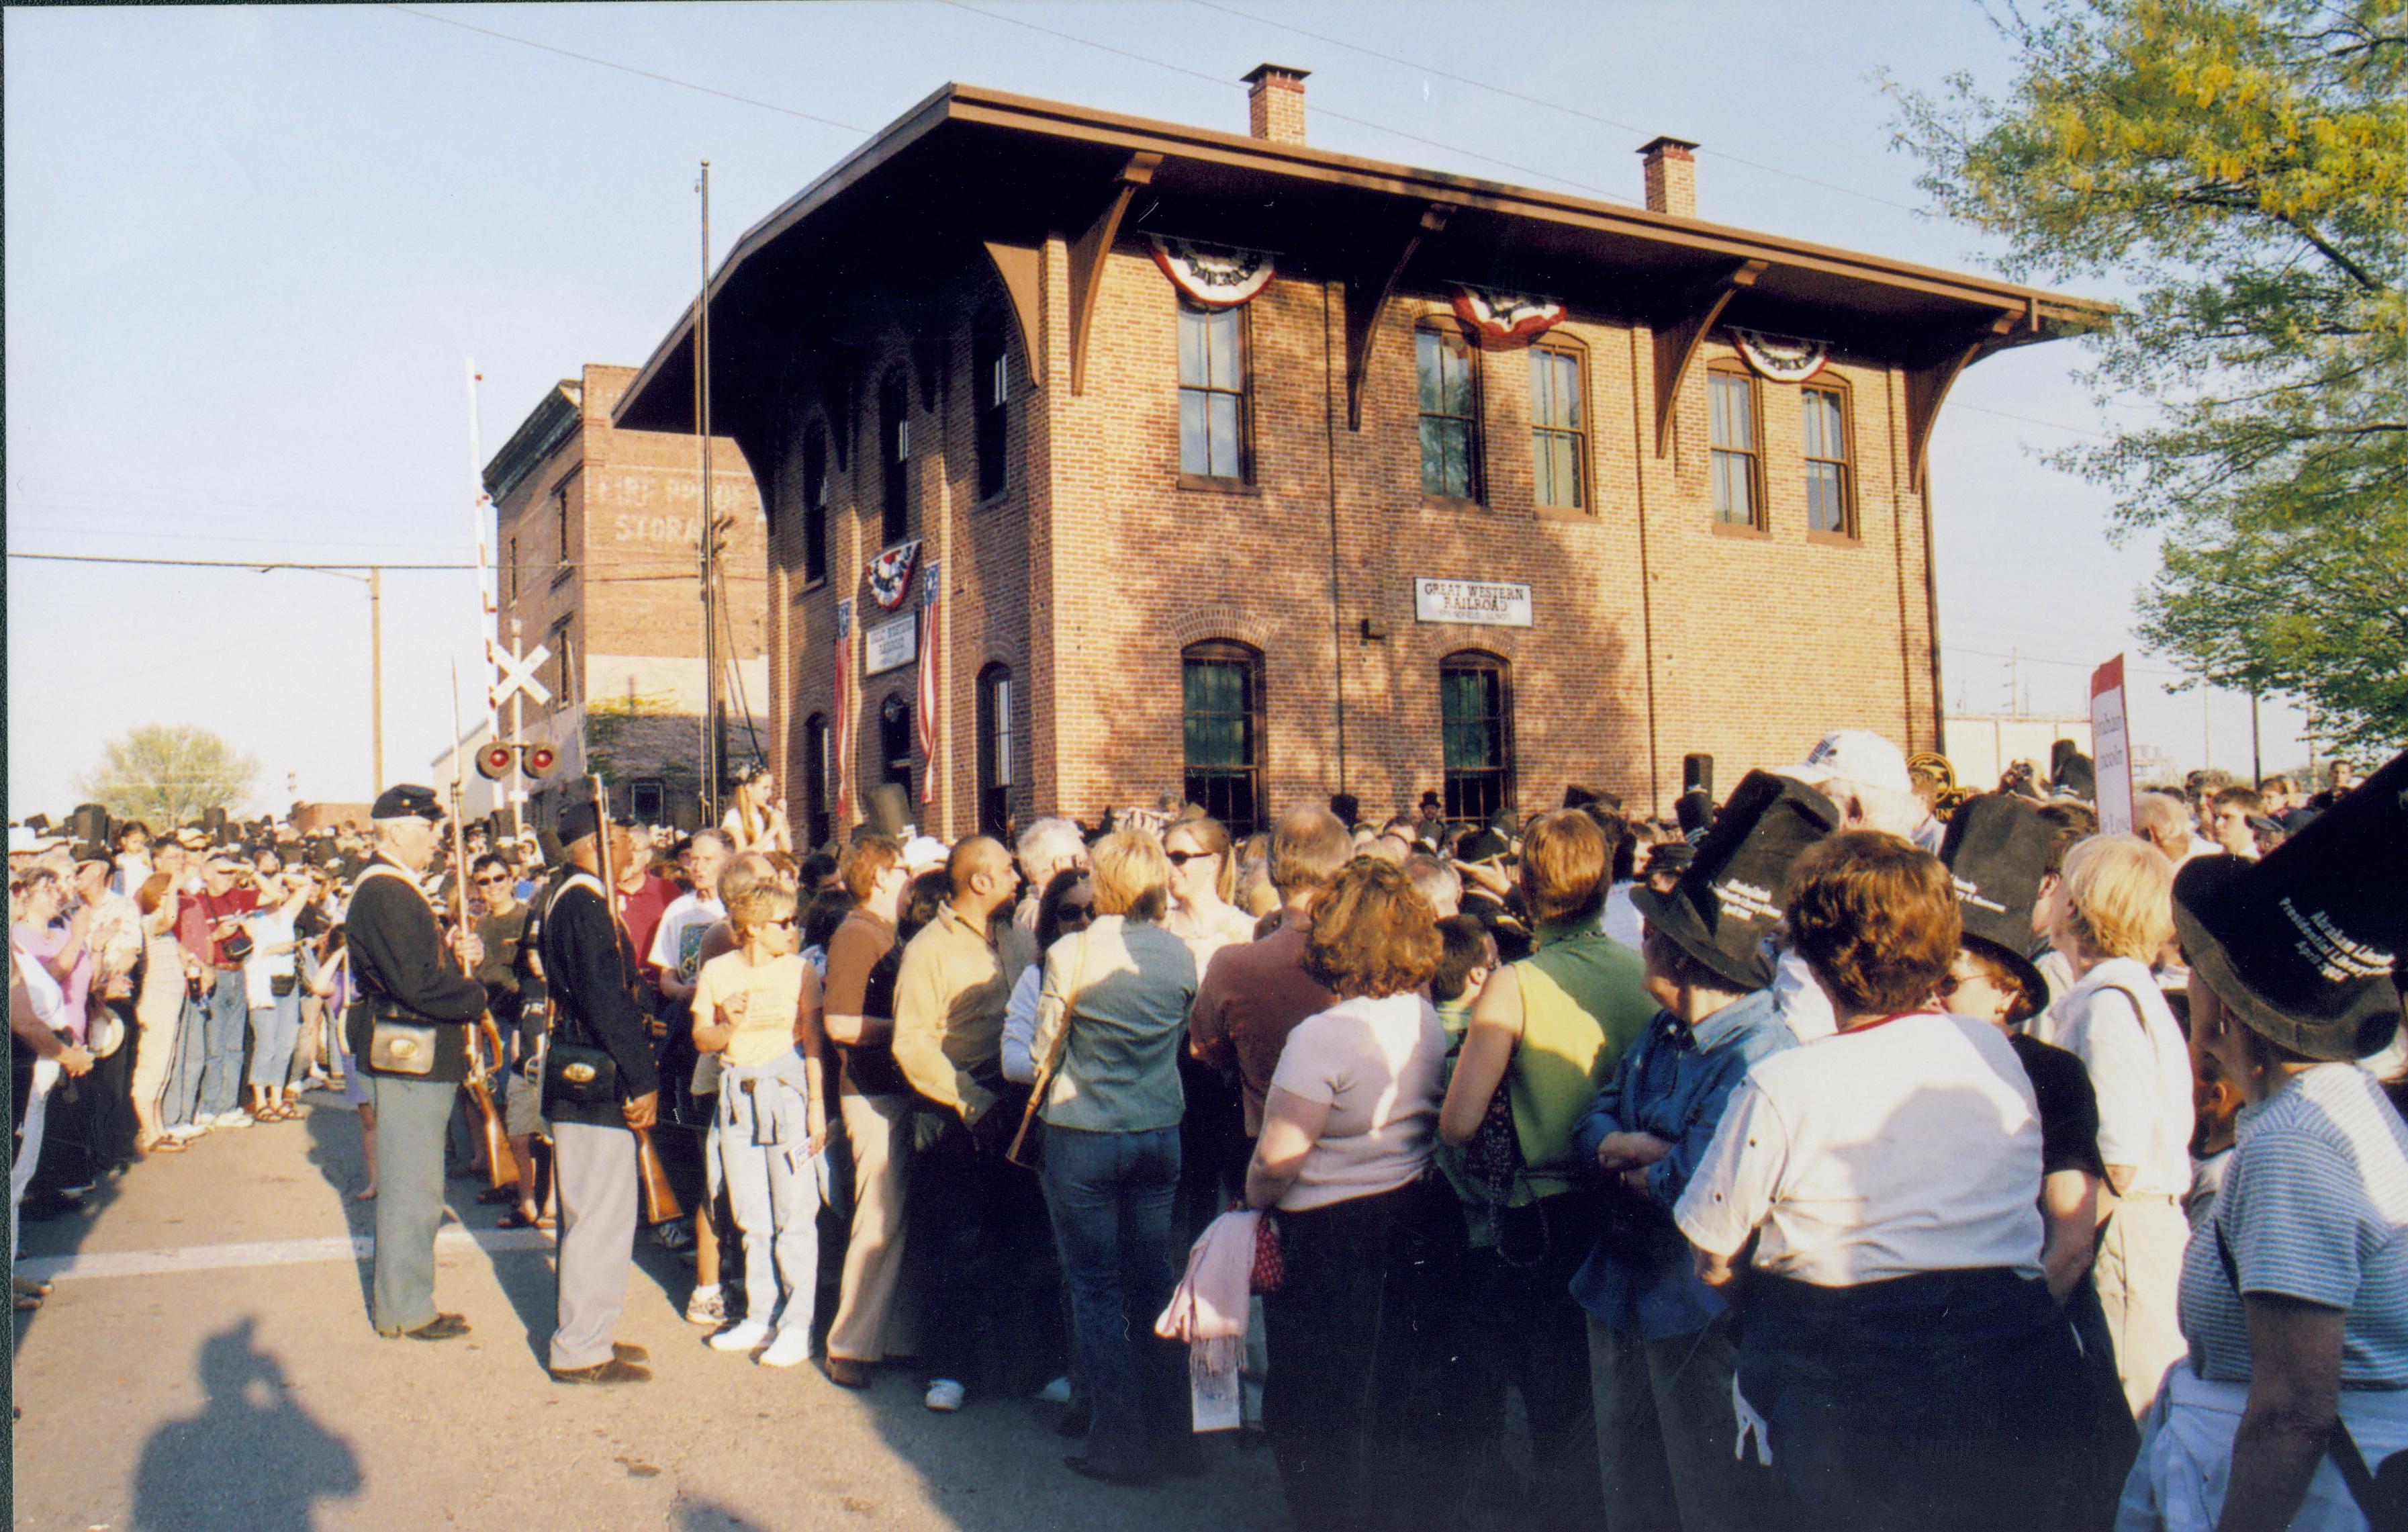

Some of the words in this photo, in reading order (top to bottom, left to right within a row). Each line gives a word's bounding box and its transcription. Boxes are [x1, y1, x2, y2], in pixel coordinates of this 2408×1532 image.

[1425, 583, 1461, 596] GREAT
[1467, 585, 1524, 600] WESTERN
[1444, 596, 1508, 612] RAILROAD
[2278, 897, 2335, 956] Presidential
[2309, 911, 2358, 954] Abraham
[2295, 941, 2323, 965] April
